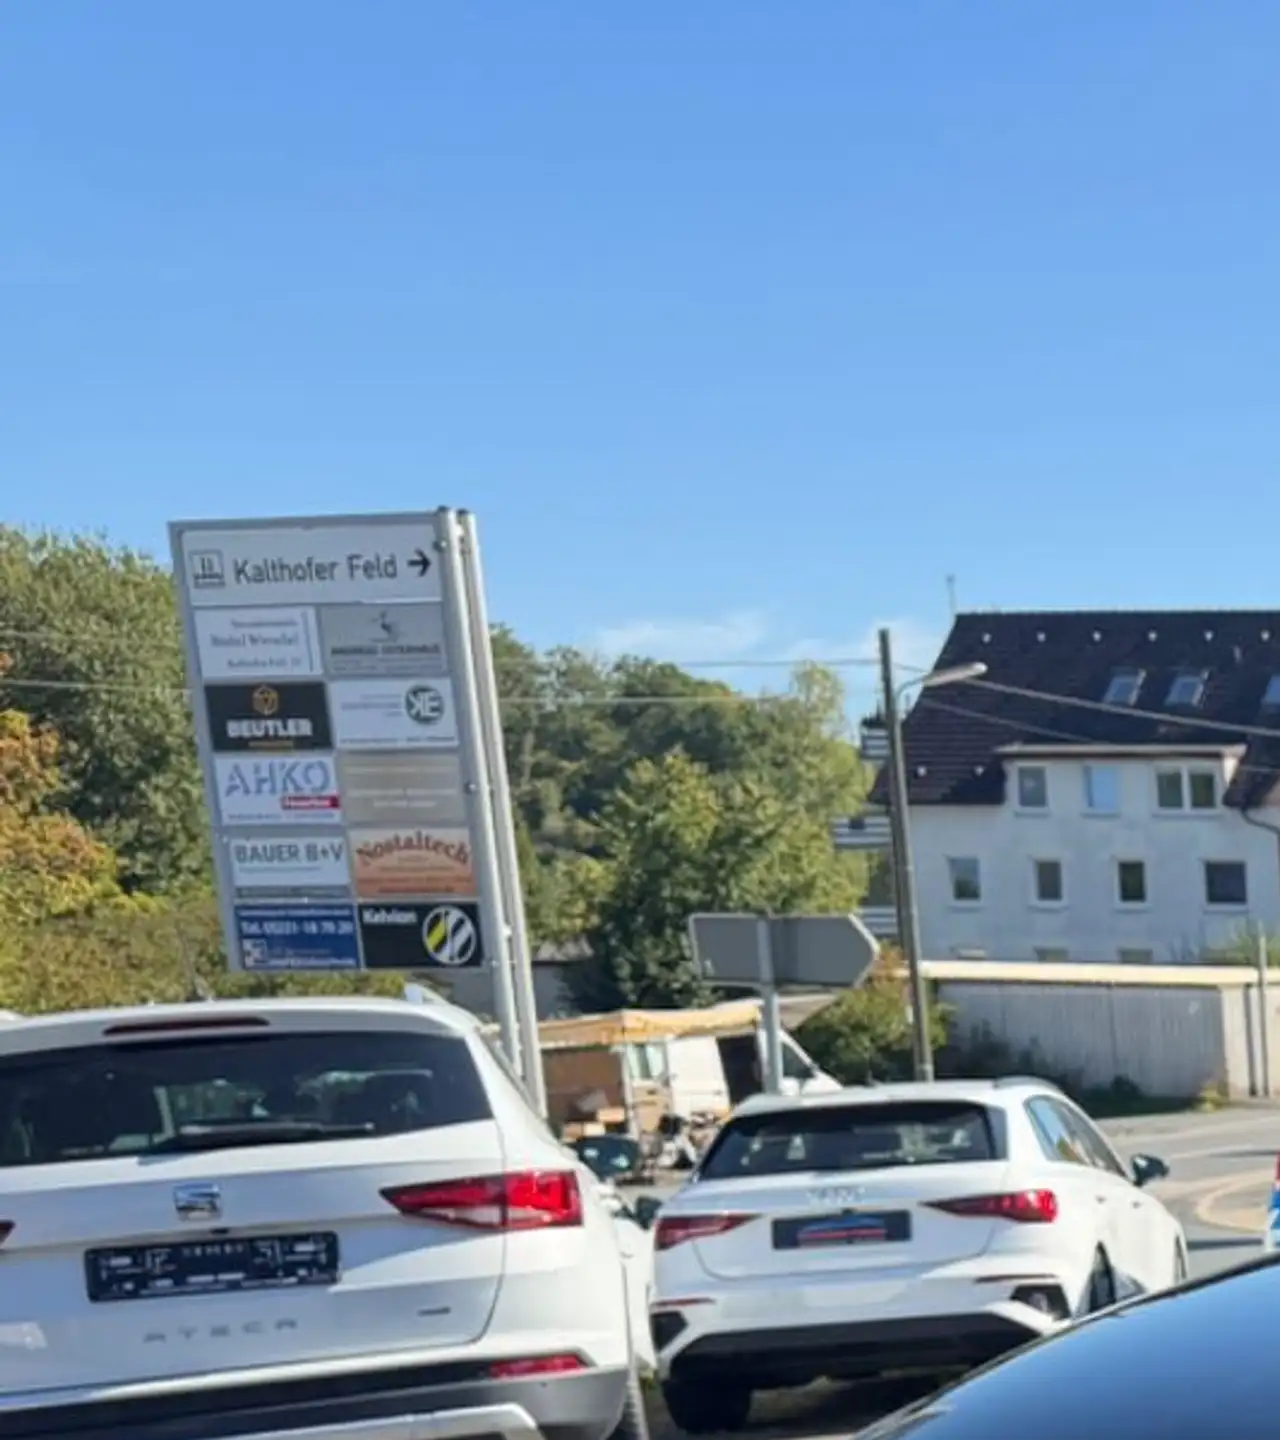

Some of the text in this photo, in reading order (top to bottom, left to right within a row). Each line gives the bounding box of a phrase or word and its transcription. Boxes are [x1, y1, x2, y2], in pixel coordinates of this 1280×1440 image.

[233, 551, 397, 584] Kalthofer Feld
[226, 719, 313, 738] BEUTLER
[235, 843, 299, 863] BAUER
[143, 1318, 298, 1343] ATECA
